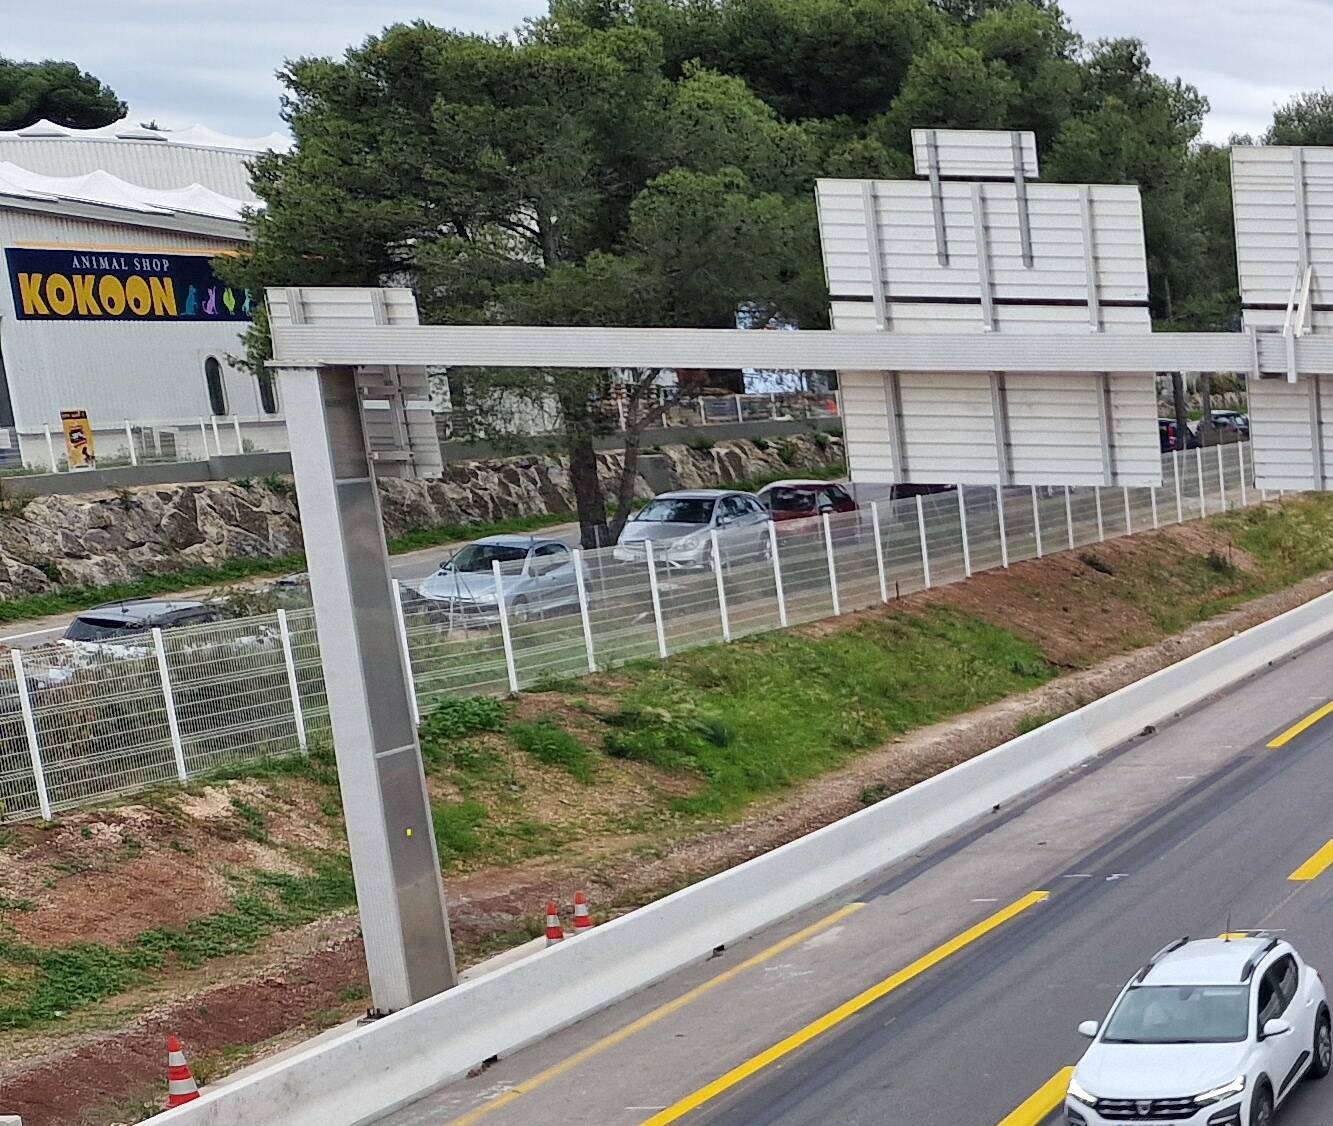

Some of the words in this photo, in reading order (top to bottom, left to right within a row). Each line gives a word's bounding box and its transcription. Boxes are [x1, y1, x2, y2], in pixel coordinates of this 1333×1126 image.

[72, 255, 129, 270] ANIMAL
[134, 257, 170, 272] SHOP
[17, 272, 178, 316] KOKOON
